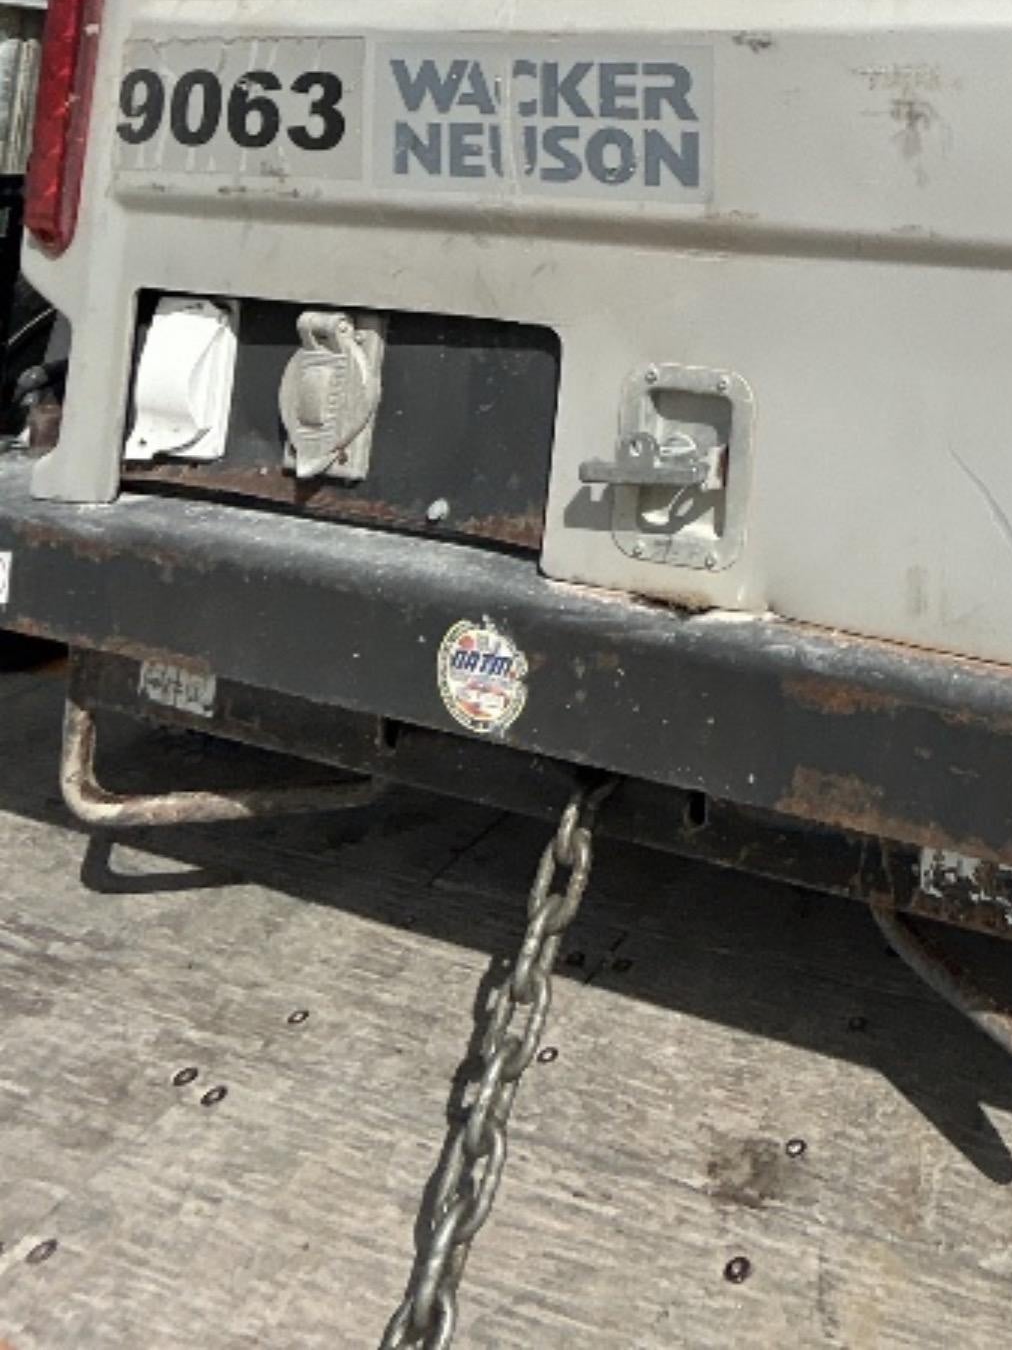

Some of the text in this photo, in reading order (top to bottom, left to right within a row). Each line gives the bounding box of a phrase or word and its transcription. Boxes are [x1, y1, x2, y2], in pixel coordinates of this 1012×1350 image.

[116, 68, 346, 151] 9063
[390, 59, 699, 121] WACKER
[393, 121, 700, 187] NEUSON
